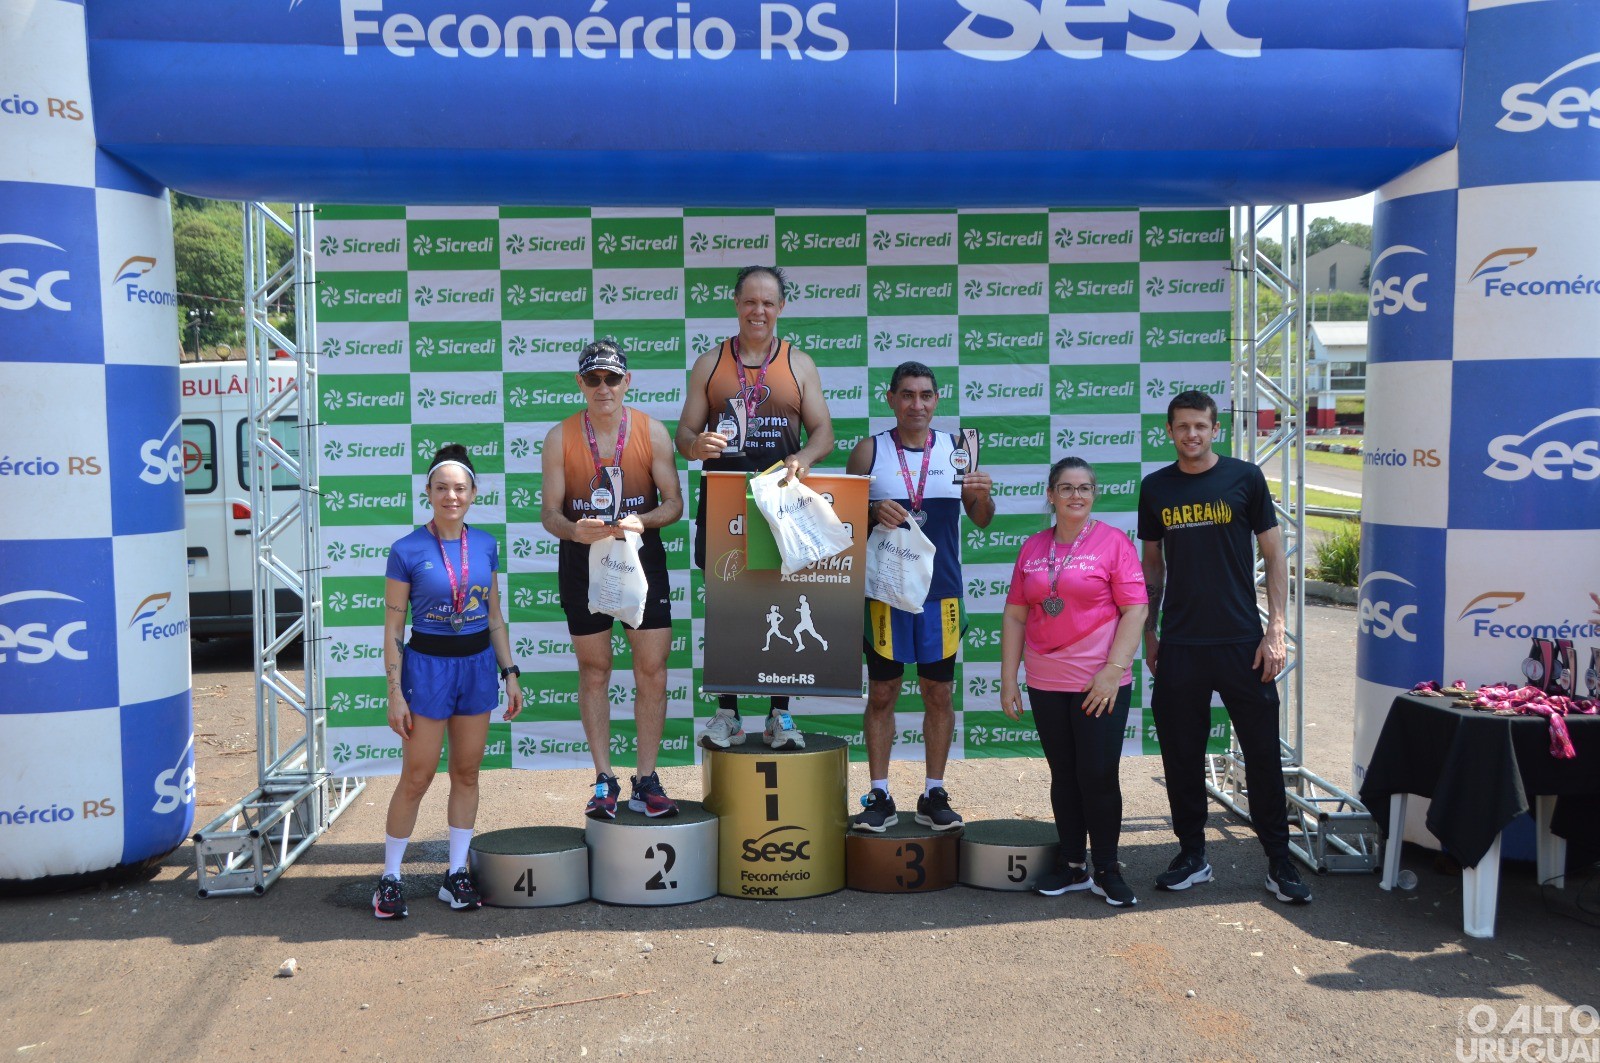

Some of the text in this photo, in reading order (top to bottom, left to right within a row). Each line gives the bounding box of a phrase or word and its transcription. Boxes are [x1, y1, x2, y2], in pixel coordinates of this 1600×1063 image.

[340, 0, 849, 61] Fecomércio RS
[47, 97, 84, 121] RS
[711, 234, 769, 250] Sicredi
[803, 233, 860, 249] Sicredi
[895, 232, 952, 248] Sicredi
[986, 231, 1043, 246] Sicredi
[1077, 229, 1134, 246] Sicredi
[1168, 227, 1225, 243] Sicredi
[343, 238, 400, 253] Sicredi
[435, 237, 494, 253] Sicredi
[529, 236, 586, 252] Sicredi
[621, 235, 678, 252] Sicredi
[0, 268, 71, 311] sc
[622, 286, 678, 302] Sicredi
[804, 283, 861, 300] Sicredi
[895, 283, 952, 298] Sicredi
[986, 281, 1043, 297] Sicredi
[1077, 280, 1133, 296] Sicredi
[1168, 279, 1225, 294] Sicredi
[1370, 272, 1428, 316] esc
[344, 288, 402, 304] Sicredi
[437, 288, 495, 304] Sicredi
[530, 288, 587, 303] Sicredi
[623, 337, 680, 352] Sicredi
[805, 334, 862, 350] Sicredi
[896, 333, 952, 349] Sicredi
[987, 332, 1044, 348] Sicredi
[1078, 331, 1134, 347] Sicredi
[1167, 329, 1226, 345] Sicredi
[345, 339, 403, 356] Sicredi
[438, 339, 496, 355] Sicredi
[624, 388, 681, 402] Sicredi
[823, 386, 862, 400] credi
[987, 382, 1044, 398] Sicredi
[1078, 381, 1134, 397] Sicredi
[347, 391, 405, 408] Sicredi
[440, 390, 497, 406] Sicredi
[988, 432, 1045, 448] Sicredi
[1079, 431, 1135, 446] Sicredi
[347, 442, 405, 458] Sicredi
[1363, 448, 1441, 468] mércio RS
[1483, 434, 1600, 481] Ses
[0, 456, 101, 476] ércio RS
[990, 482, 1045, 497] Sicredi
[1096, 480, 1135, 495] credi
[350, 492, 406, 508] Sicredi
[1161, 502, 1214, 527] GARRA
[989, 532, 1029, 546] Sicre
[350, 544, 390, 558] Sicre
[781, 571, 851, 584] Academia
[351, 594, 385, 608] Sicr
[1359, 597, 1418, 643] esc
[353, 644, 385, 658] Sicr
[757, 672, 815, 685] Seberi-RS
[354, 694, 389, 709] Sicr
[539, 690, 579, 704] Sicre
[991, 728, 1040, 742] Sicred
[540, 739, 591, 753] Sicred
[755, 761, 778, 822] 1
[83, 797, 116, 819] RS
[644, 842, 678, 891] 2
[895, 842, 926, 889] 3
[1007, 855, 1028, 883] 5
[513, 868, 537, 898] 4
[740, 869, 811, 882] Fecomércio
[741, 884, 779, 896] Senac
